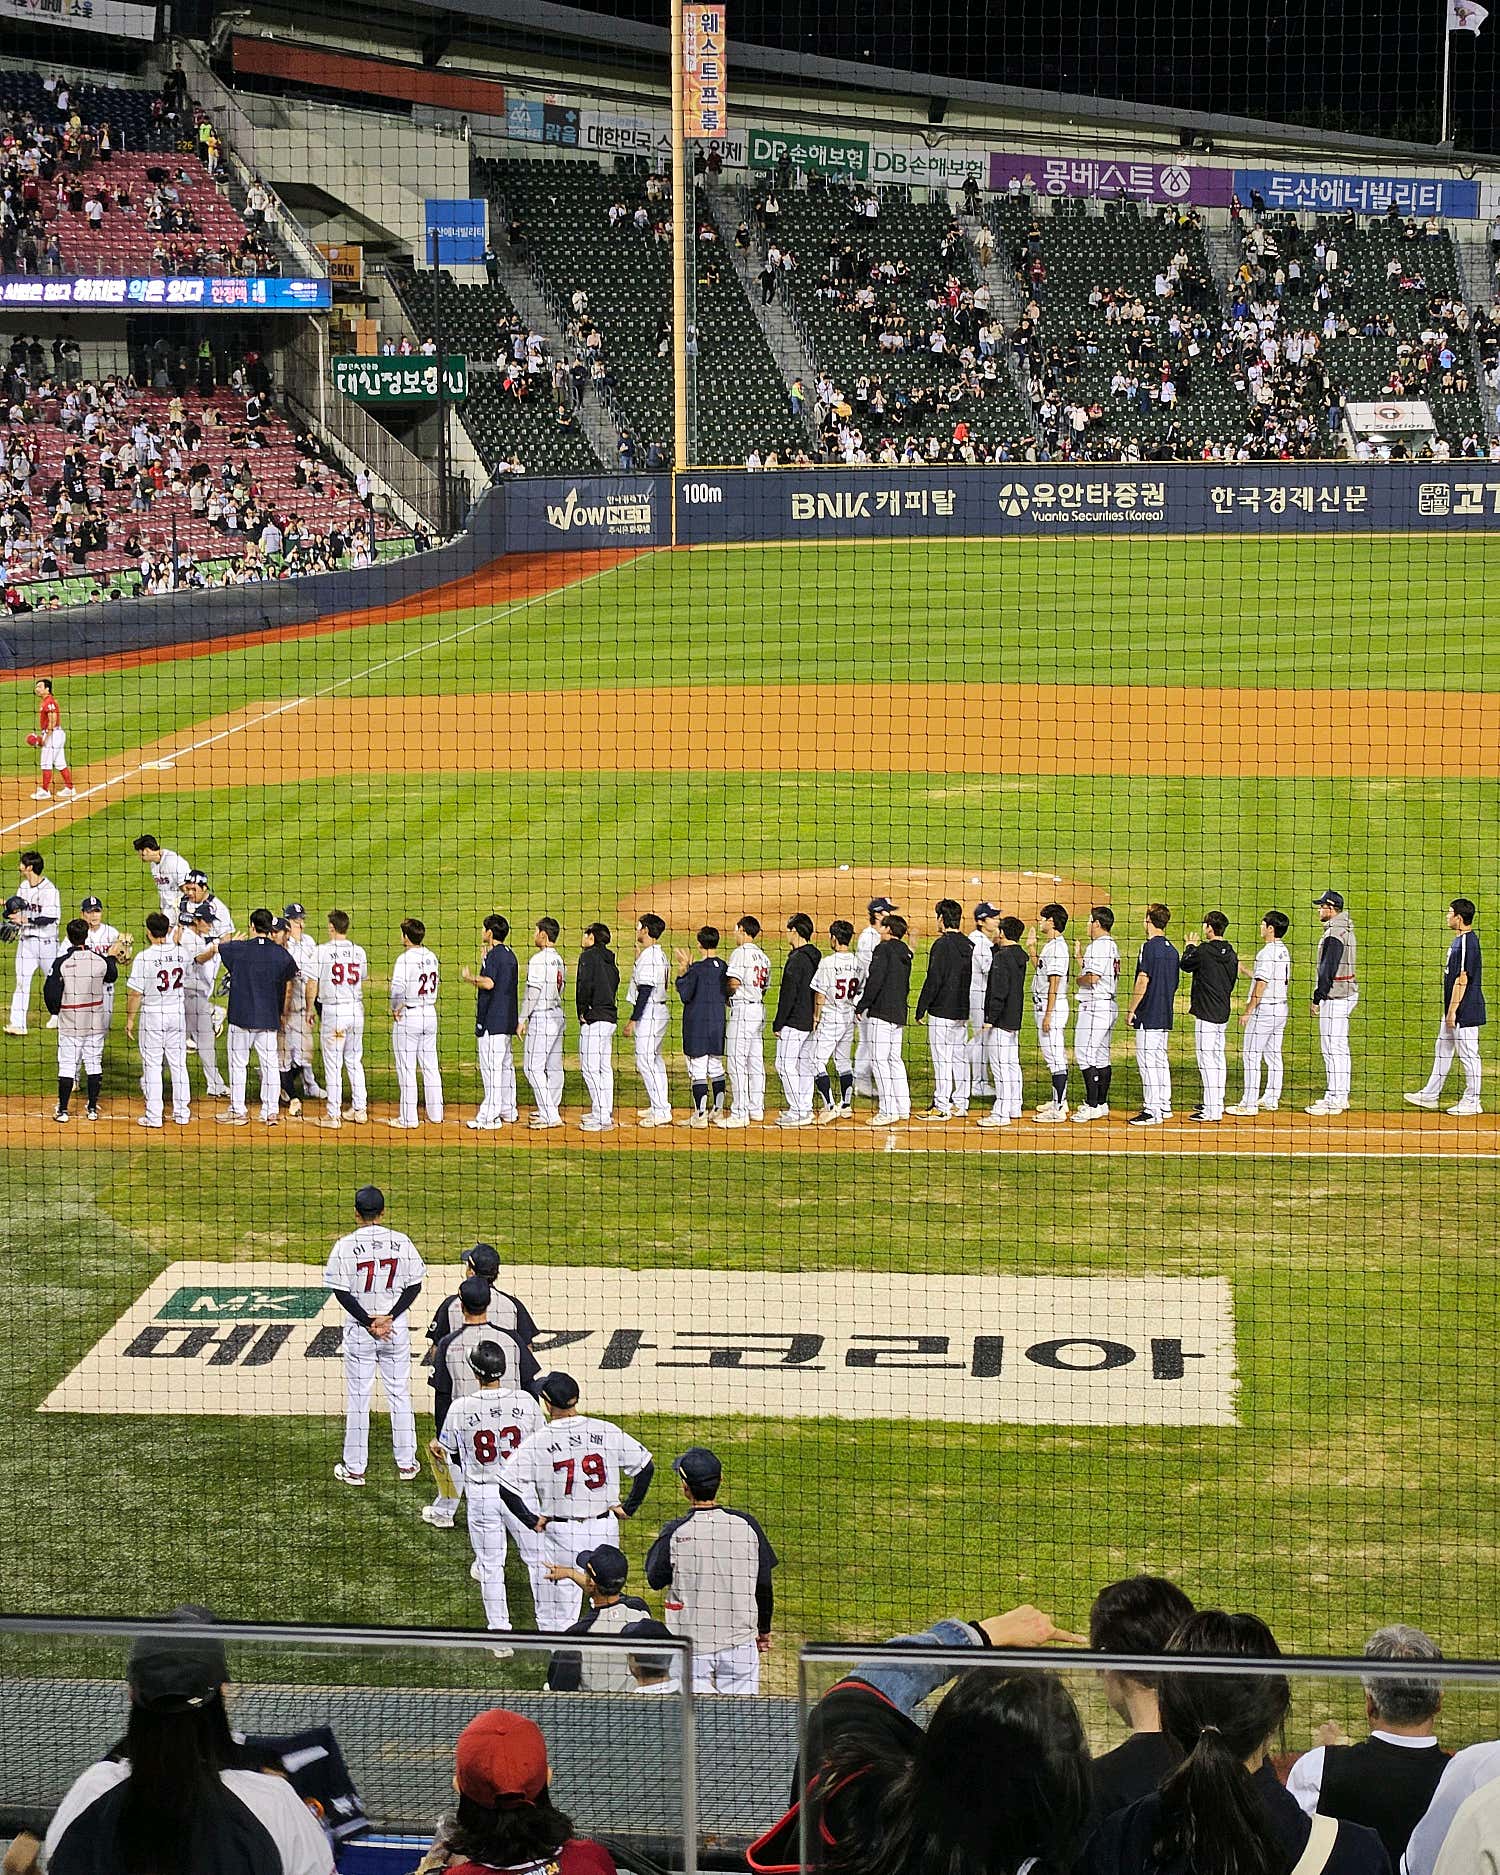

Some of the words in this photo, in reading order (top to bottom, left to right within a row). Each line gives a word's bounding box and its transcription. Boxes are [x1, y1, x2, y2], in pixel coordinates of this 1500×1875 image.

[700, 13, 719, 130] 웨스트프롬
[587, 125, 652, 152] 대한민국
[754, 138, 863, 170] DB손해보험
[874, 151, 983, 180] DB손해보험
[1043, 159, 1155, 195] 몽베스트
[1268, 177, 1443, 213] 두산에너빌리티
[73, 279, 126, 302] 하지만
[682, 483, 722, 504] 100m
[791, 492, 871, 520] BNK
[875, 489, 957, 516] 캐피탈
[1031, 482, 1165, 508] 유안타증권
[1210, 485, 1368, 514] 한국경제신문
[1031, 511, 1070, 522] Yuanta
[1071, 510, 1124, 522] Securities
[1125, 509, 1164, 522] (Korea)
[157, 967, 184, 992] 32
[331, 963, 360, 986] 95
[418, 971, 437, 996] 23
[835, 978, 860, 1000] 58
[356, 1257, 399, 1293] 77
[473, 1425, 522, 1466] 83
[553, 1452, 607, 1496] 79
